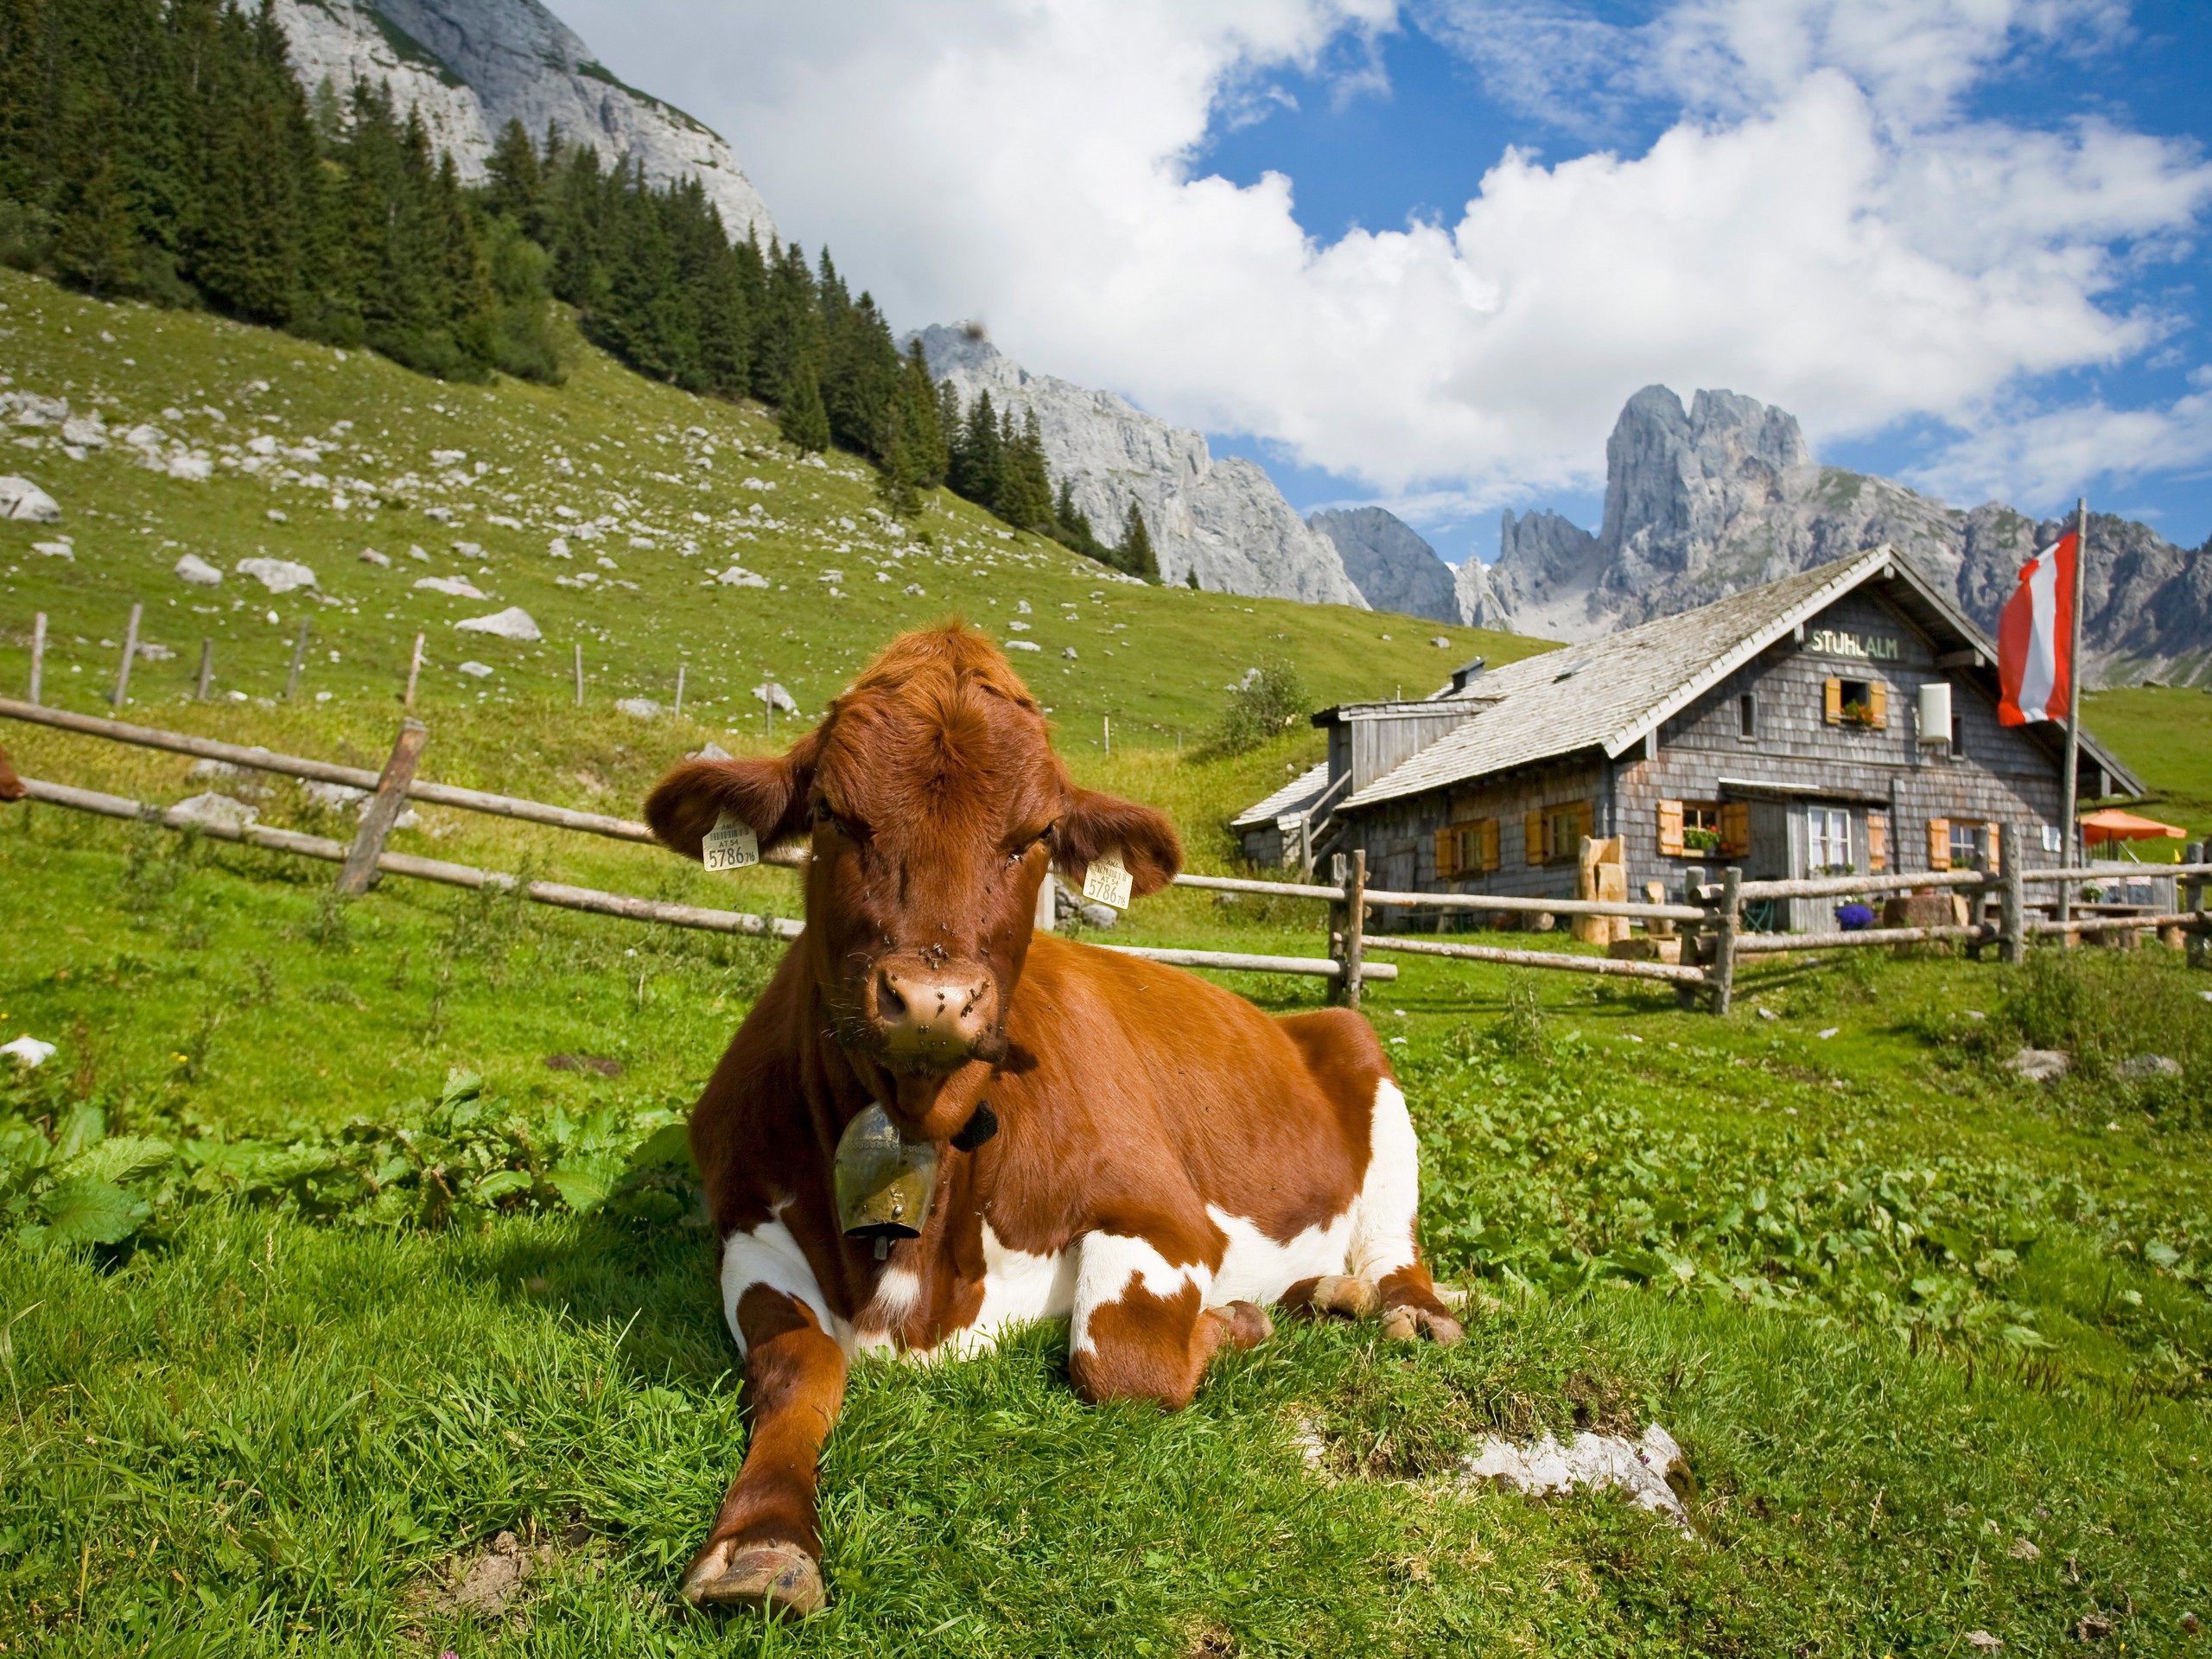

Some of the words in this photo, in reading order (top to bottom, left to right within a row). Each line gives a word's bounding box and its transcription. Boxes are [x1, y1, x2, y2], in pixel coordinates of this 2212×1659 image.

[1811, 630, 1898, 659] STUHLALM
[709, 847, 744, 868] 5786
[1101, 874, 1109, 883] AT
[1089, 879, 1117, 903] 5786
